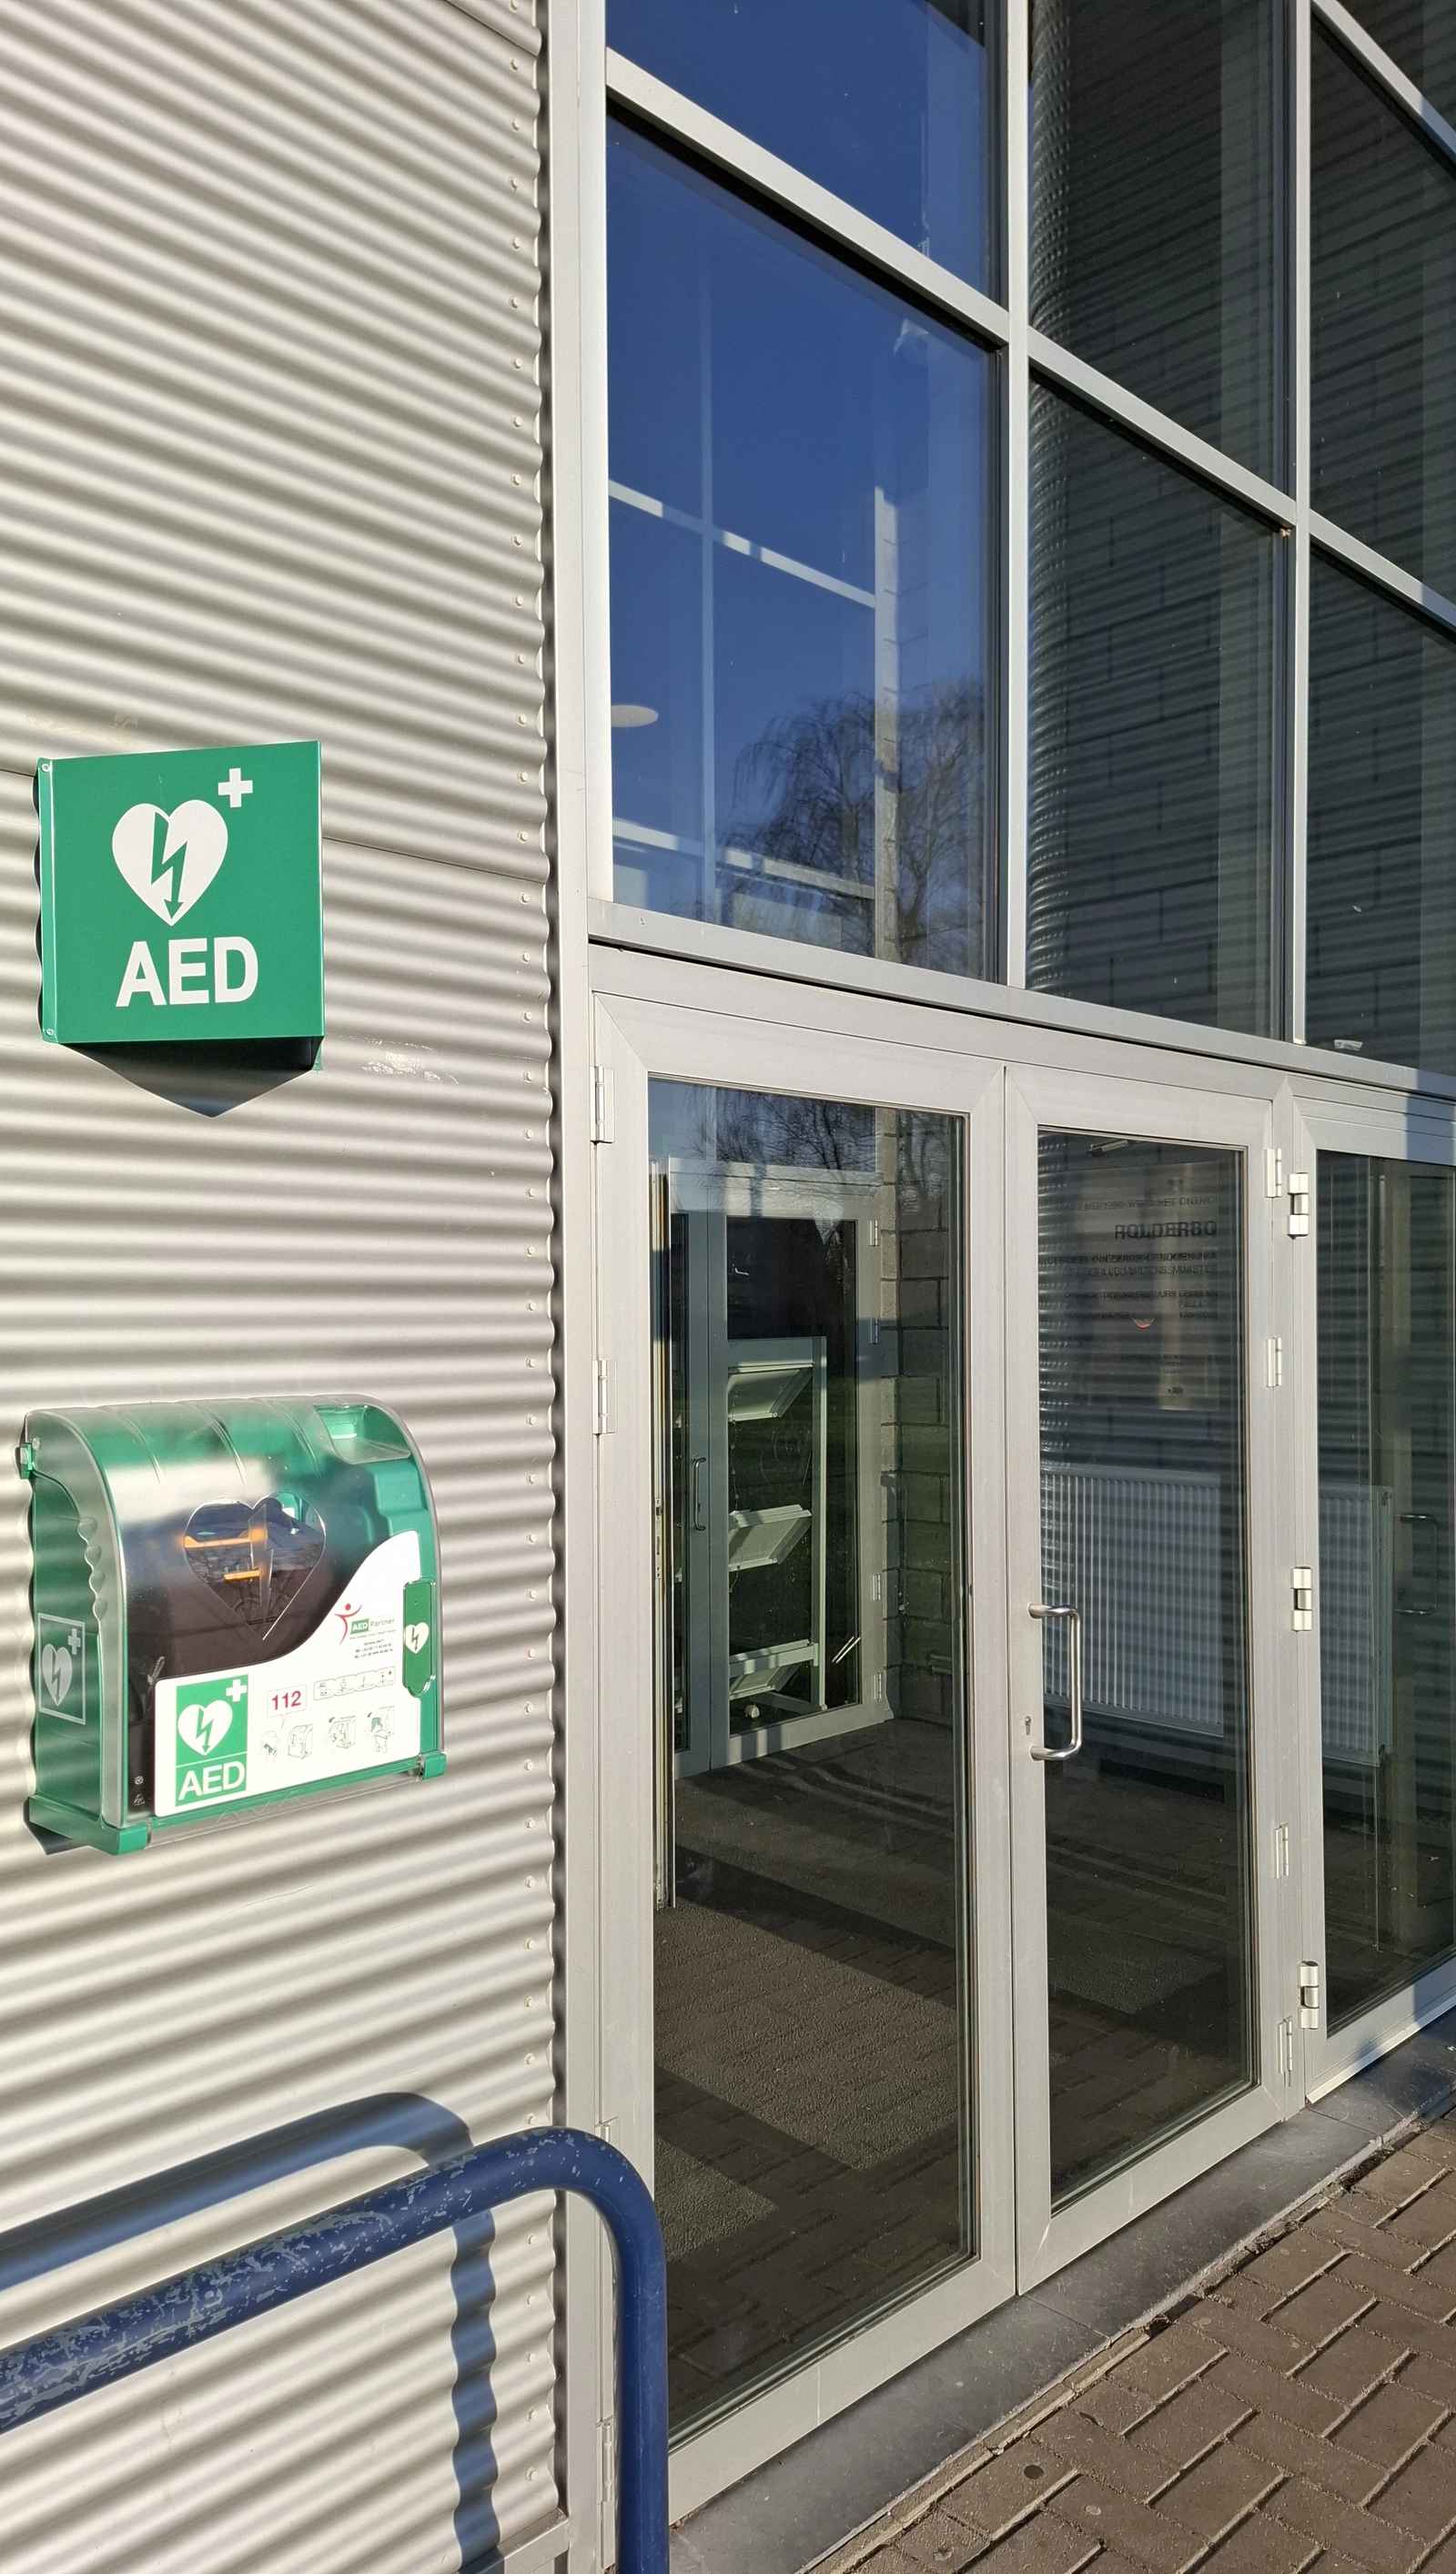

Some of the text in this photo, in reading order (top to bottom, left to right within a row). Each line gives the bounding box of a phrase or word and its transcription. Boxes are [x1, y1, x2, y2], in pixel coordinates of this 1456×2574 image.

[116, 936, 258, 1008] AED
[272, 1690, 302, 1710] 112
[178, 1761, 246, 1800] AED
